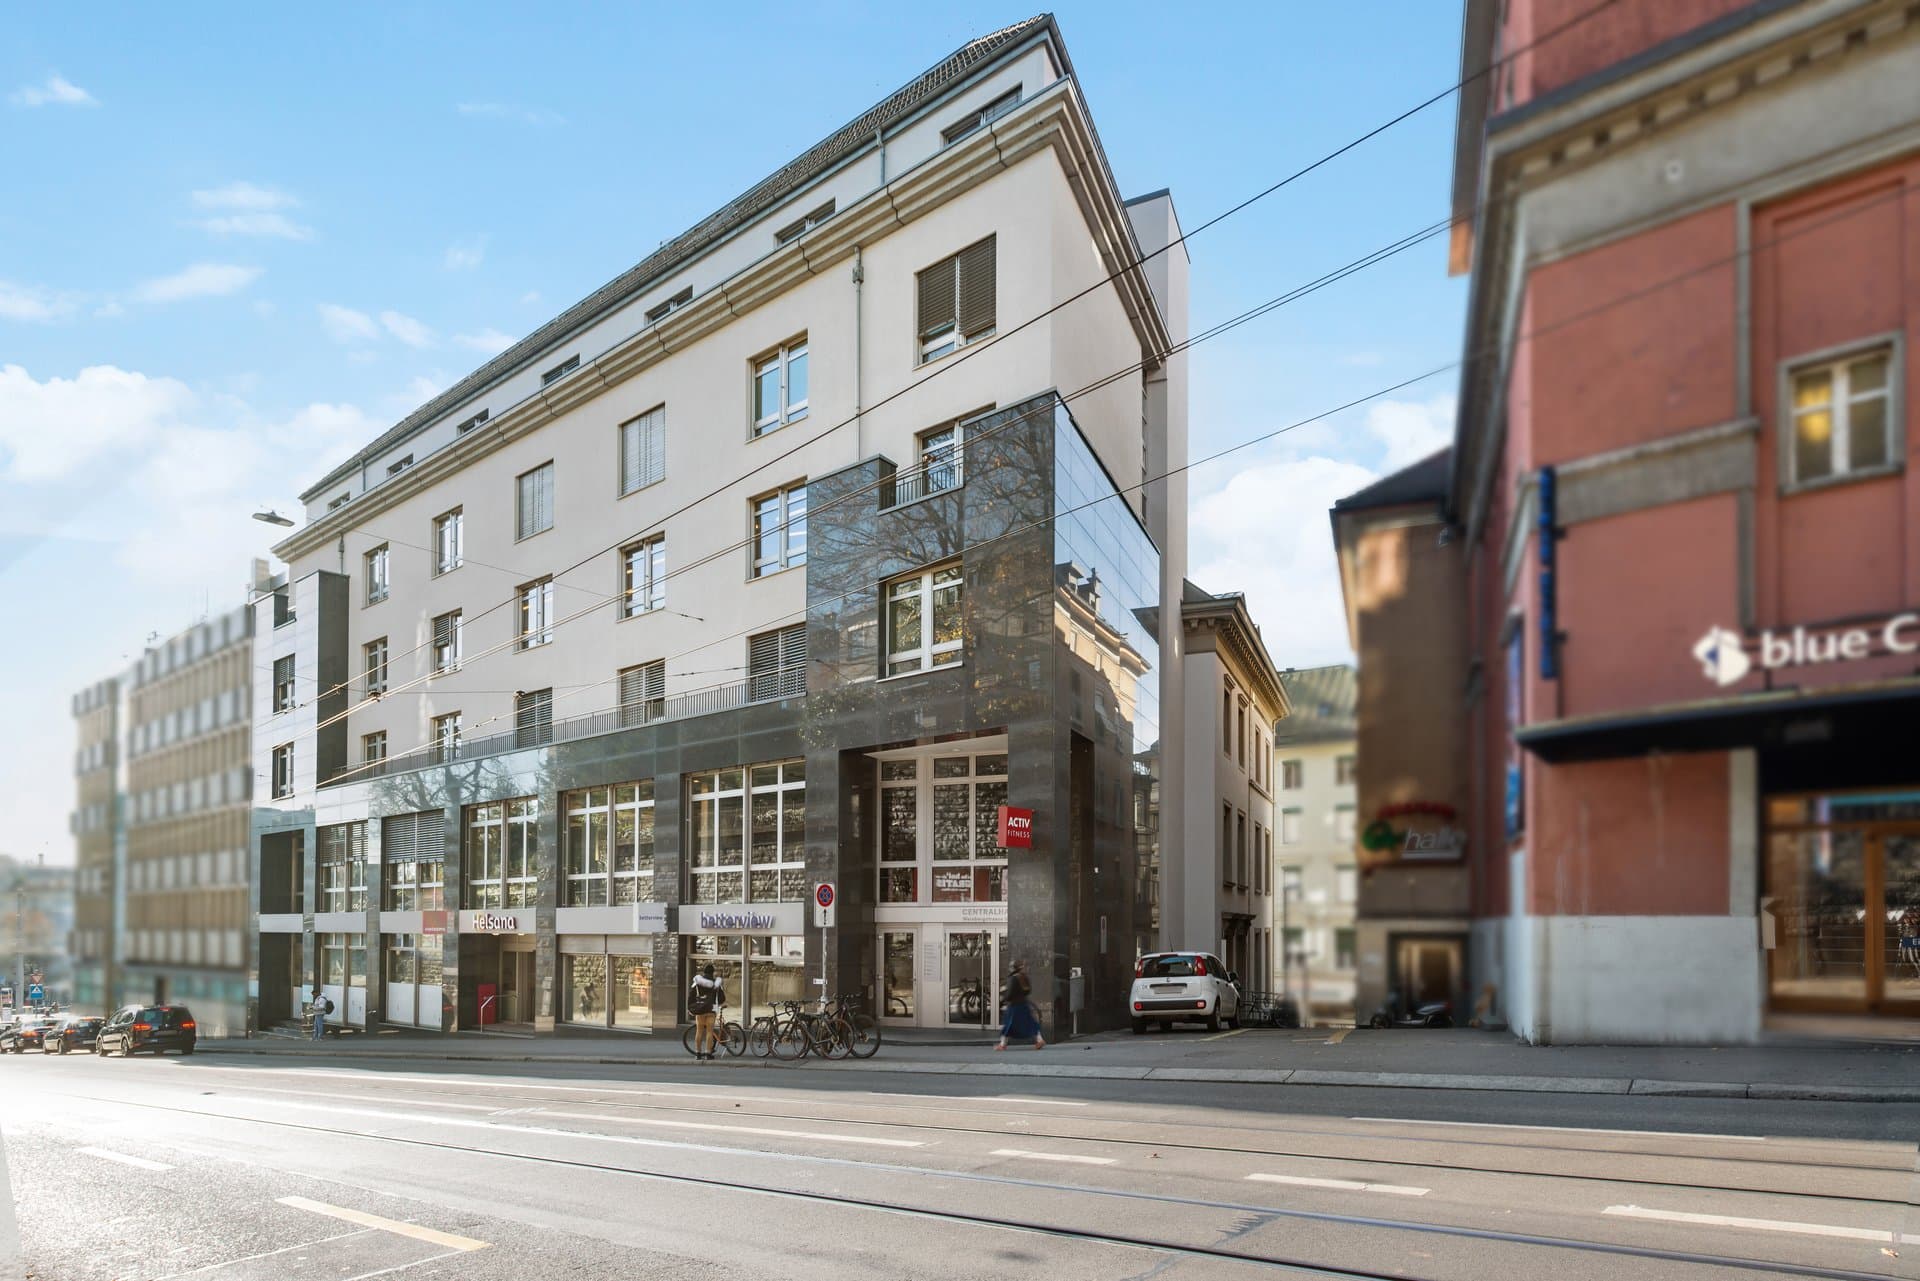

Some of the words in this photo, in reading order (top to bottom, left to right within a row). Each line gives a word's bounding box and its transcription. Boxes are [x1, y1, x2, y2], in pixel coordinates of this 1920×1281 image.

[1762, 626, 1869, 668] blue
[1007, 816, 1030, 828] ACTIV
[1007, 829, 1031, 839] FITNESS
[472, 913, 517, 930] Helsana
[701, 911, 776, 929] betterview
